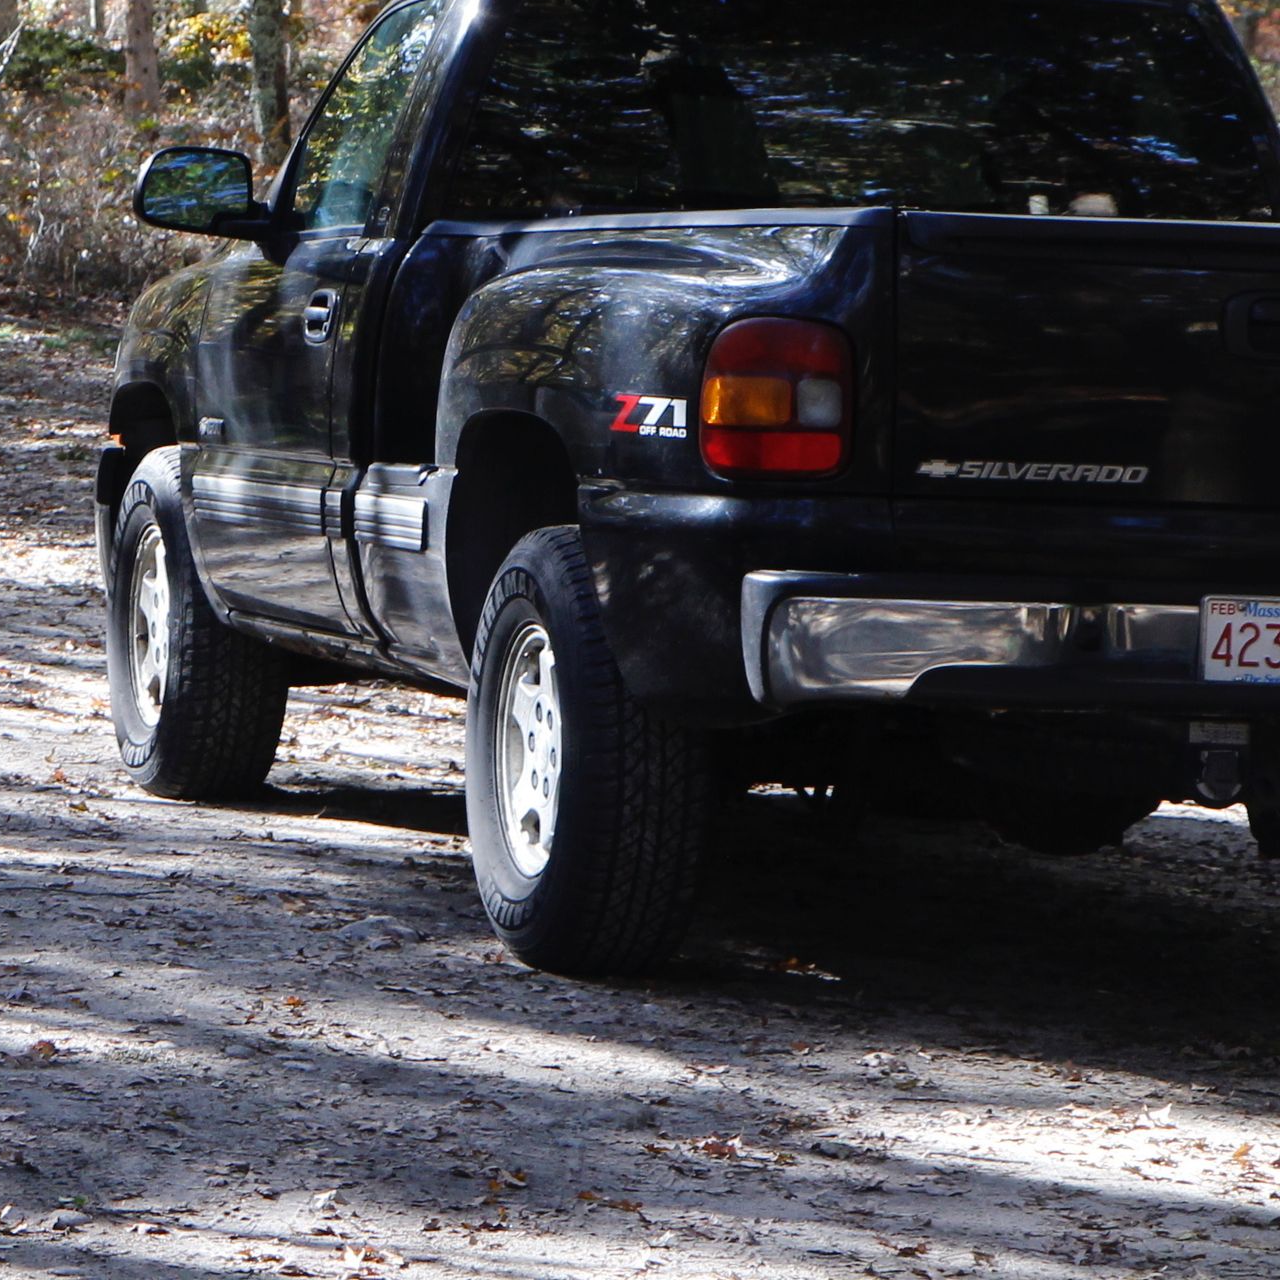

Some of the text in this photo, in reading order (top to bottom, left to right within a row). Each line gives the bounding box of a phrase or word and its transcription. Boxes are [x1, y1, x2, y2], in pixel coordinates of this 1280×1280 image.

[609, 392, 687, 433] Z71
[639, 424, 688, 439] OFF ROAD
[959, 460, 1150, 485] SILVERADO
[1211, 603, 1236, 615] FEB
